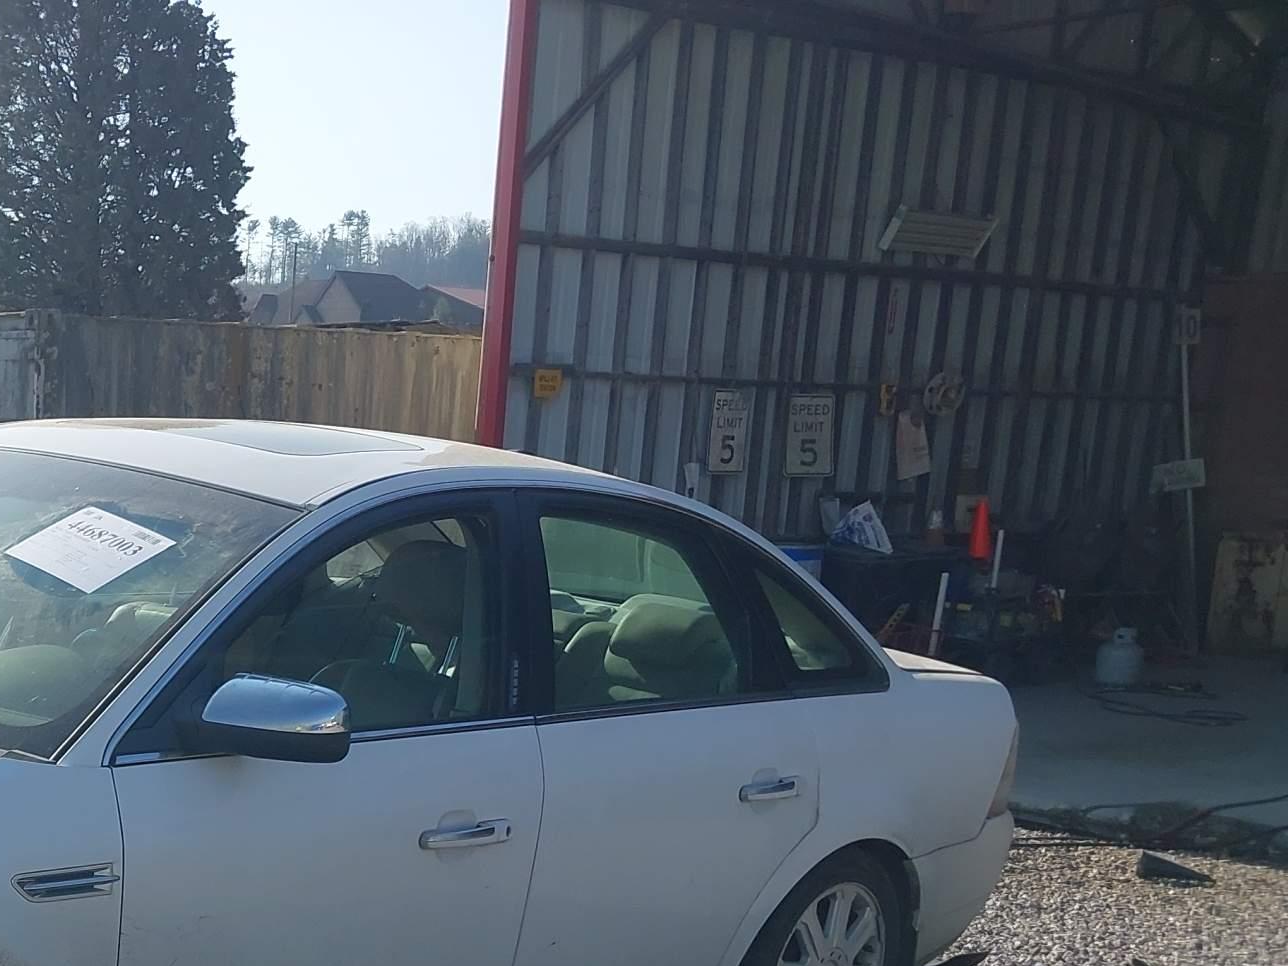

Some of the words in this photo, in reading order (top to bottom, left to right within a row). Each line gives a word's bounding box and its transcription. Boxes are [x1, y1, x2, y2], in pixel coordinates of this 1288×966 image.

[791, 403, 830, 416] SPEED
[716, 416, 743, 429] LIMIT
[793, 421, 824, 433] LIMIT
[719, 434, 735, 464] 5
[799, 438, 818, 467] 5
[67, 520, 144, 557] 44687003
